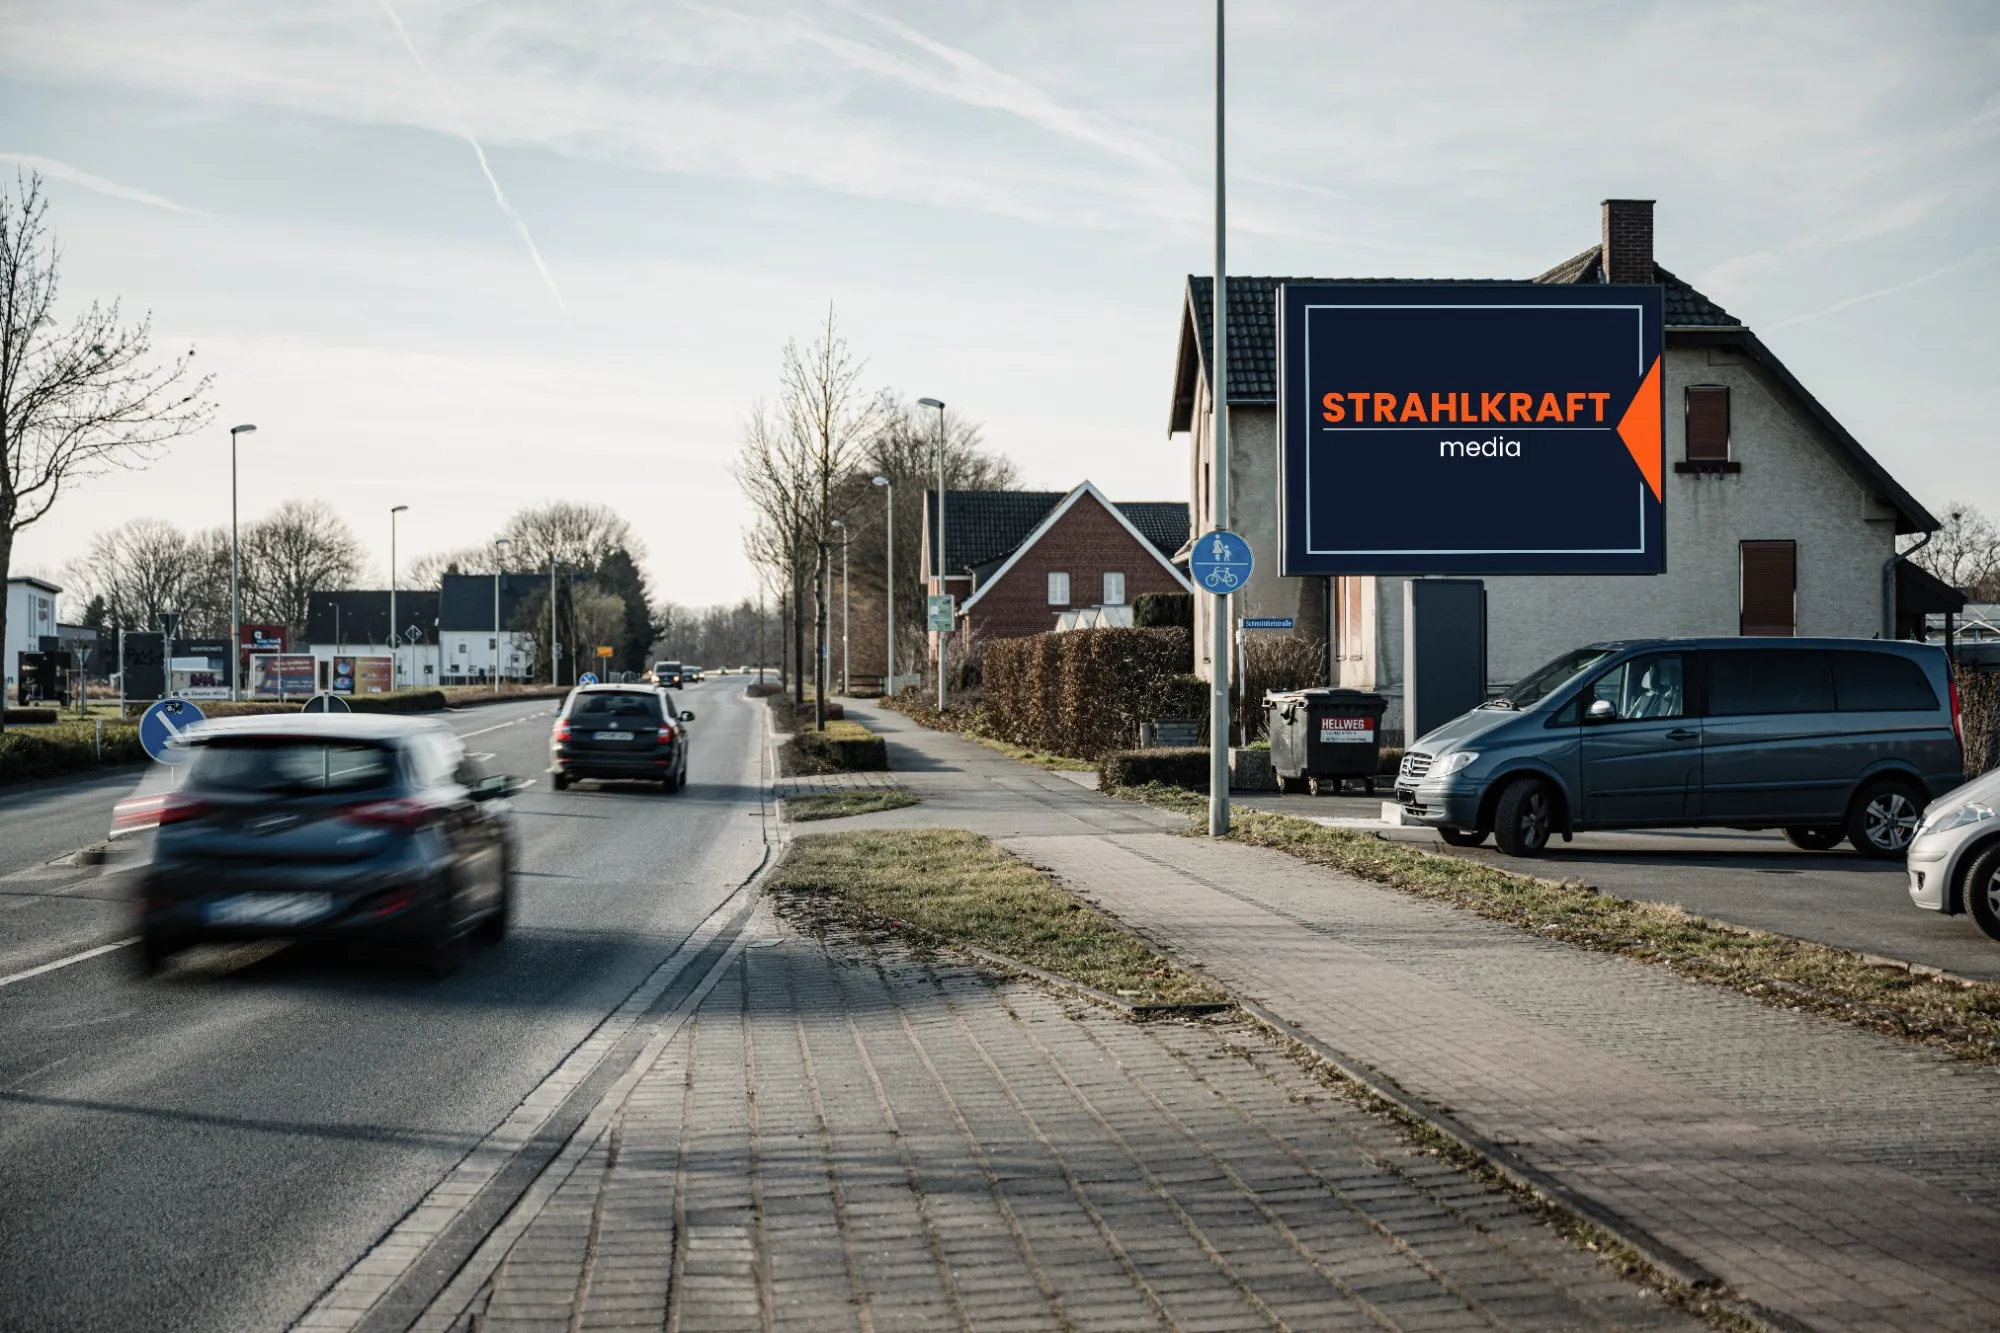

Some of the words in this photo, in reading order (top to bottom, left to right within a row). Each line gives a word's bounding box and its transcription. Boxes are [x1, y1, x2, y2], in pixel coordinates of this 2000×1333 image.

[1322, 392, 1611, 423] STRAHLKRAFT
[1440, 436, 1521, 457] media
[1321, 718, 1365, 730] HELLWEG
